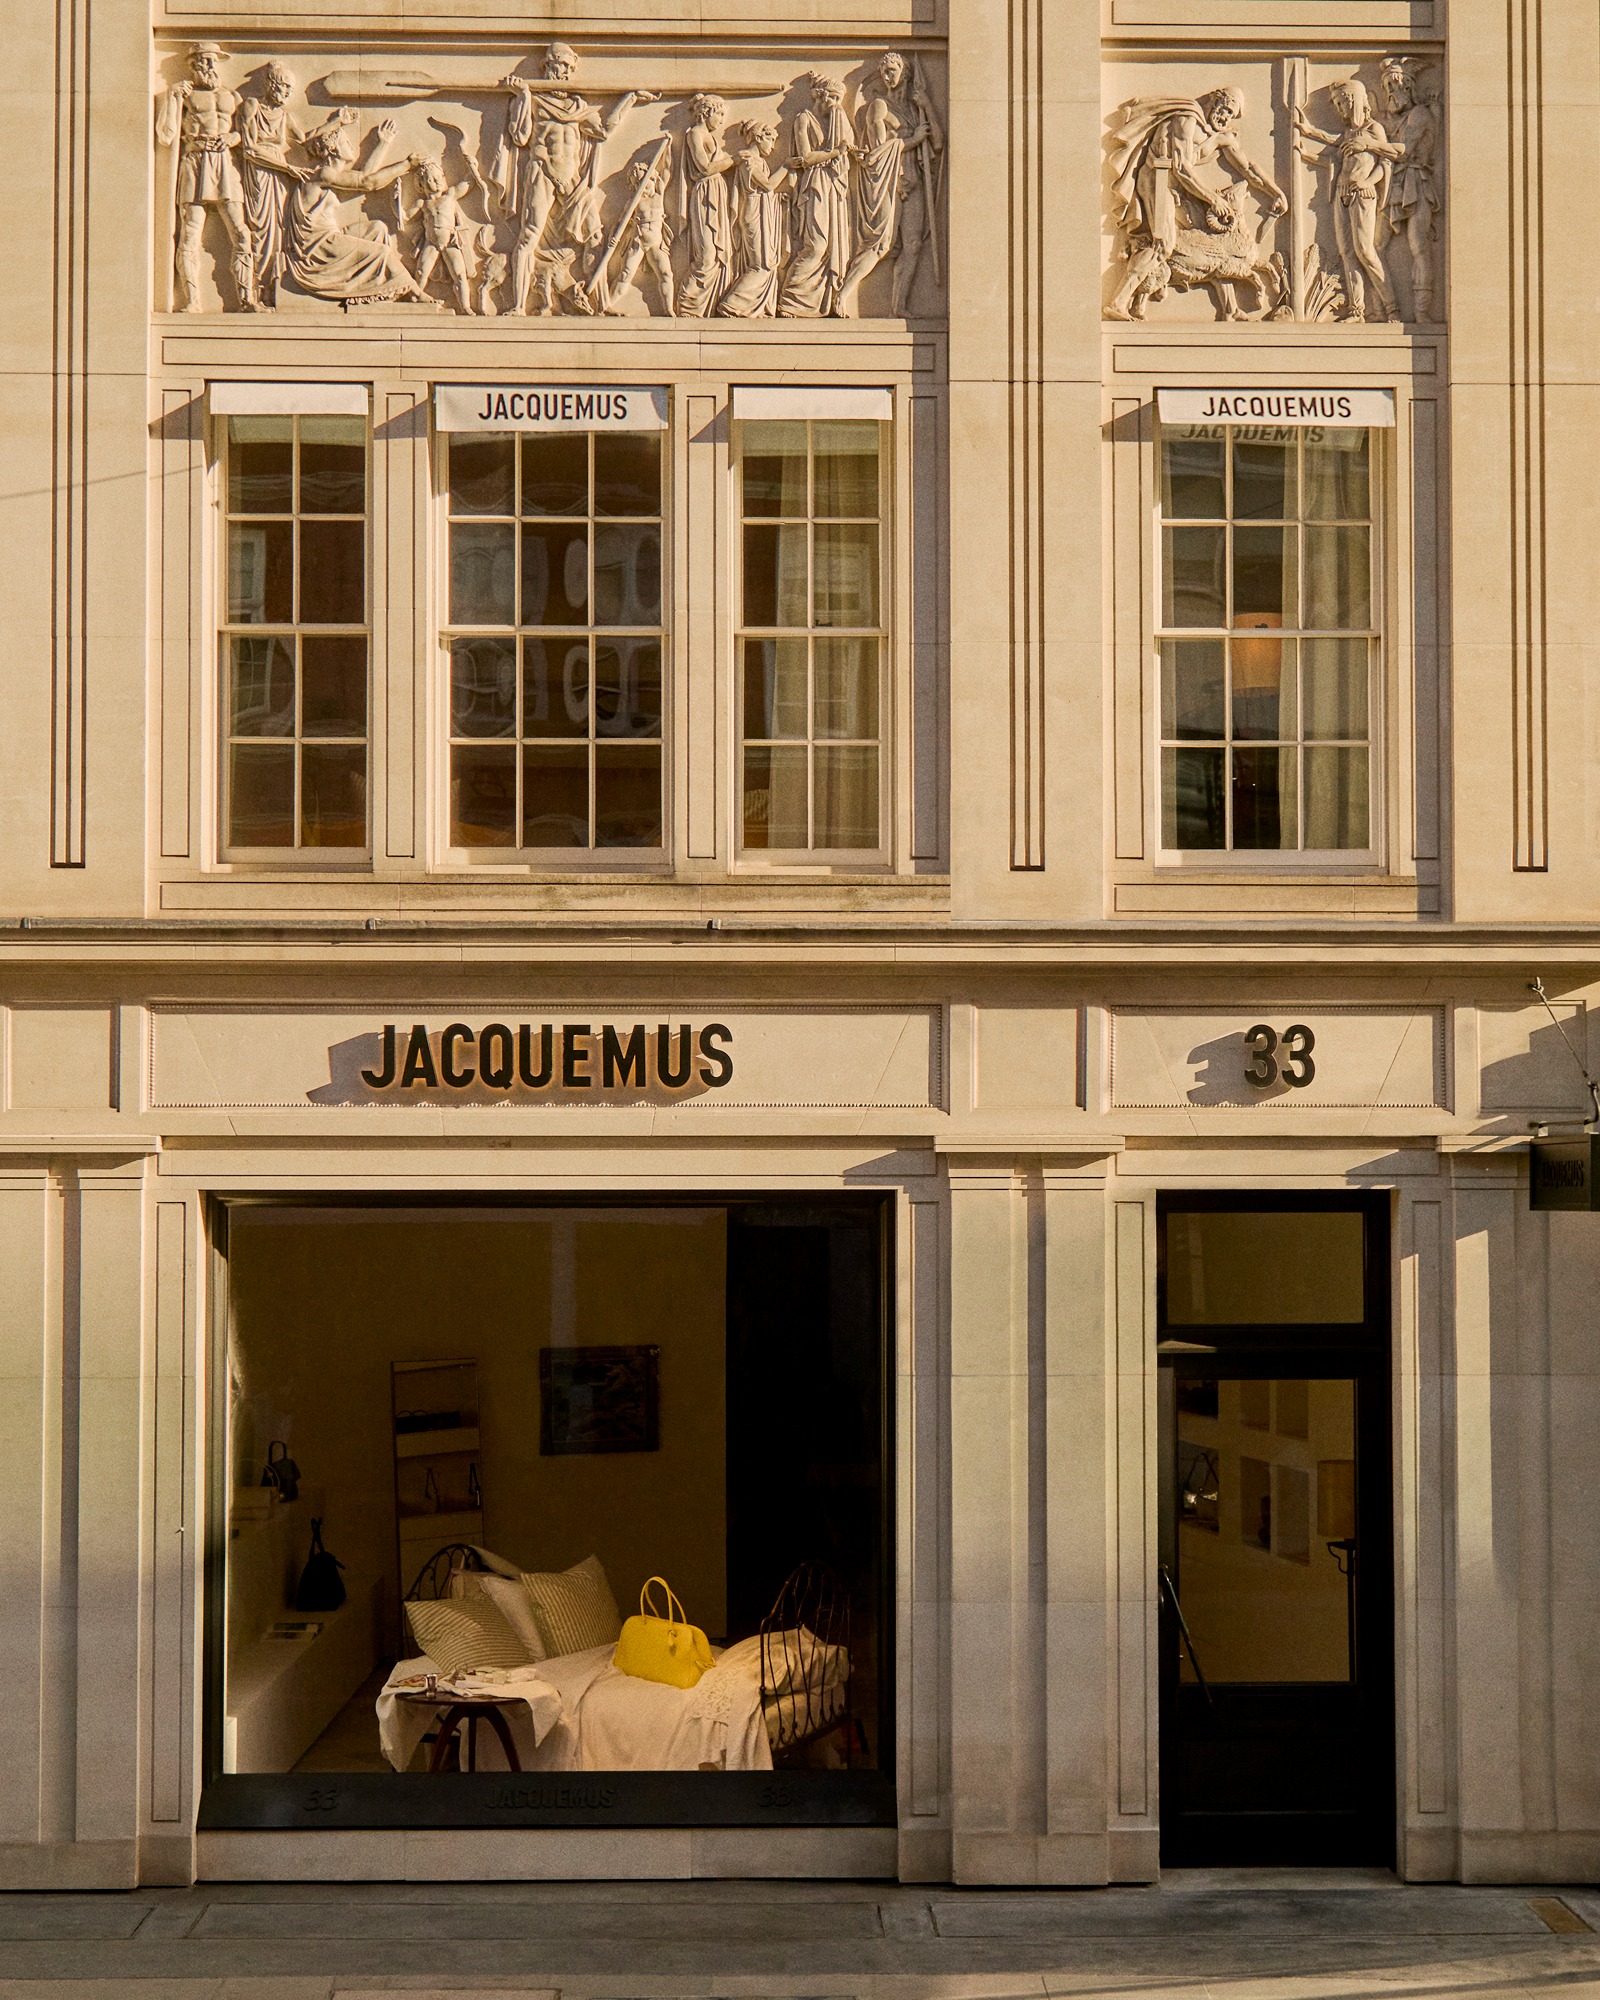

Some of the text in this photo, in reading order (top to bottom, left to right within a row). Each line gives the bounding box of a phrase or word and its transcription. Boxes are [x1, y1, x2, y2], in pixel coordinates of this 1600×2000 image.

[478, 393, 628, 421] JACQUEMUS
[1202, 396, 1352, 418] JACQUEMUS
[361, 1023, 733, 1089] JACQUEMUS
[1244, 1024, 1315, 1087] 33
[483, 1787, 618, 1809] JACQUEMUS
